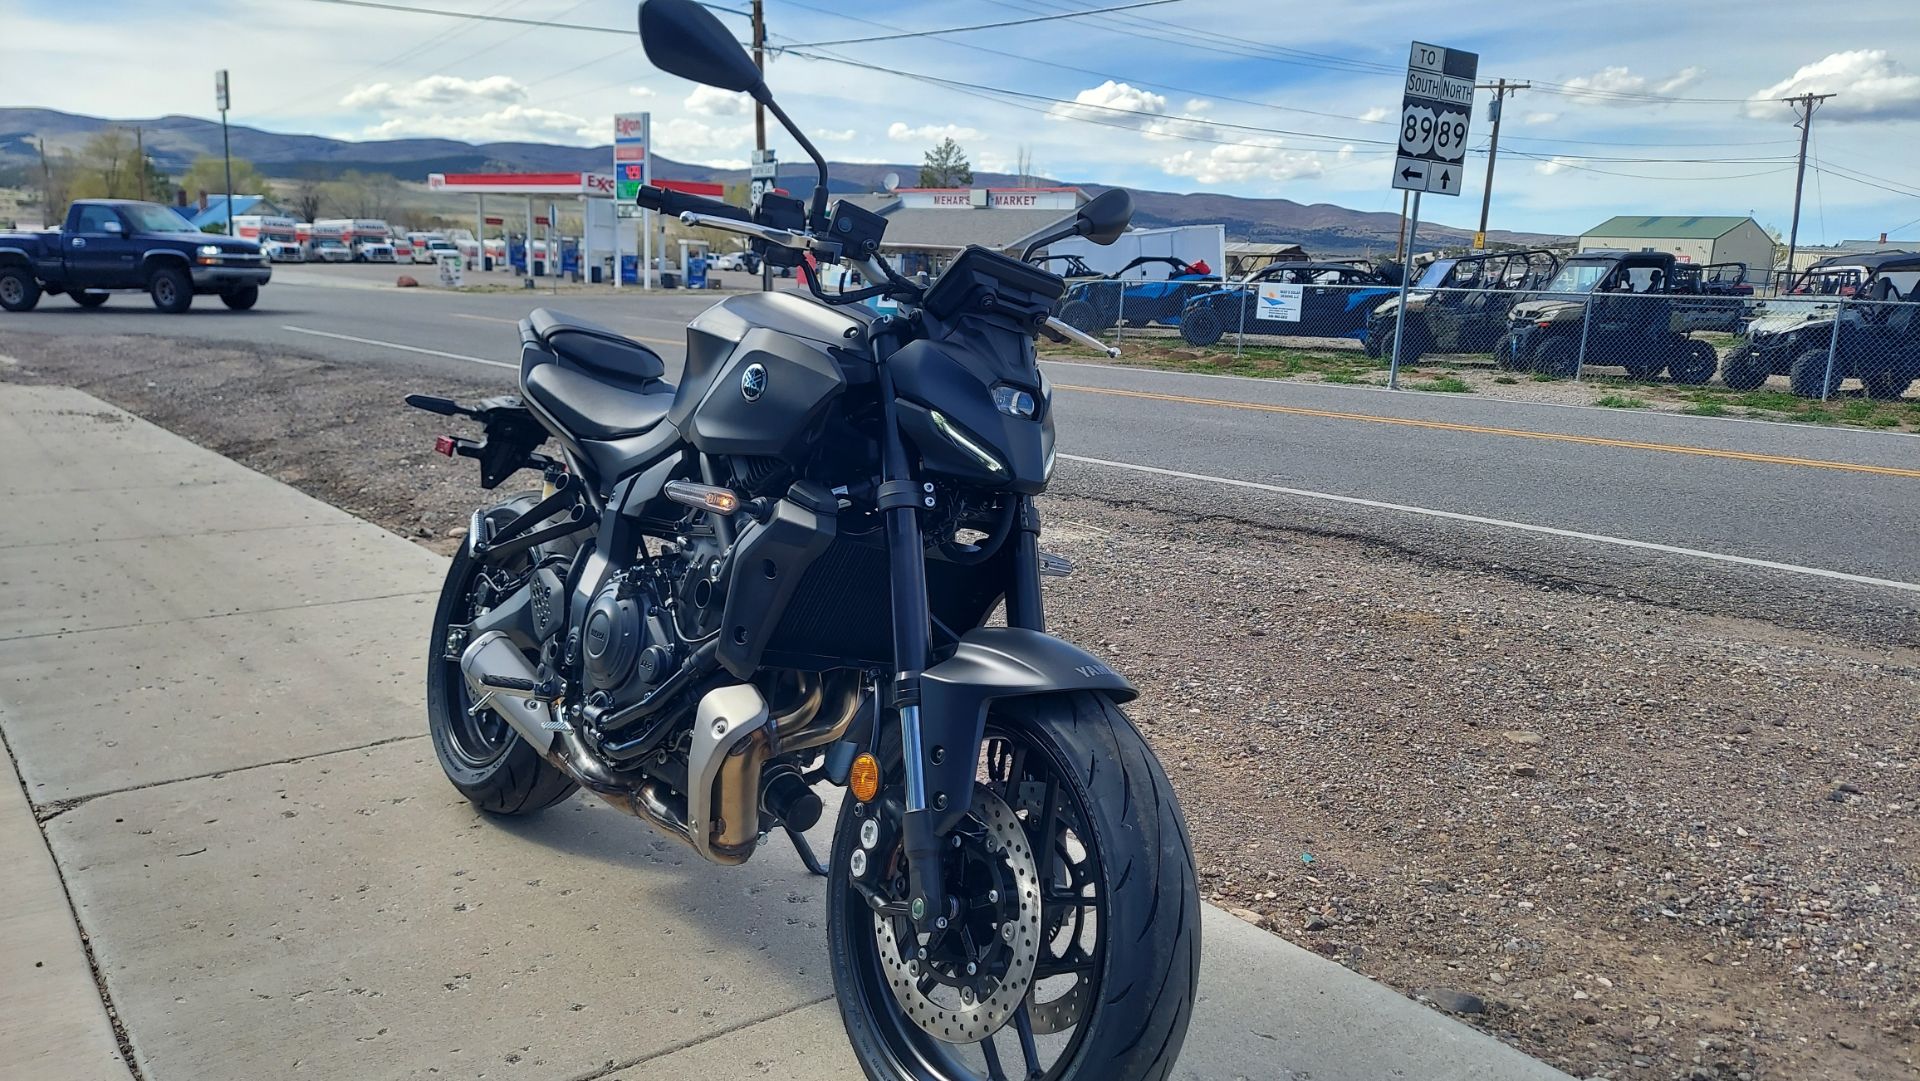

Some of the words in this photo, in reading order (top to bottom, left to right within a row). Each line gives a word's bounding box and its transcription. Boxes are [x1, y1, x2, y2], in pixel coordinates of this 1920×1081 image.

[1420, 48, 1436, 66] TO
[1408, 74, 1439, 96] SOUTH
[1443, 80, 1473, 101] NORTH
[1404, 114, 1433, 144] 89
[1438, 121, 1466, 149] 89
[588, 175, 614, 192] Exxo
[934, 195, 970, 206] MEHAR'S
[995, 195, 1037, 206] MARKET
